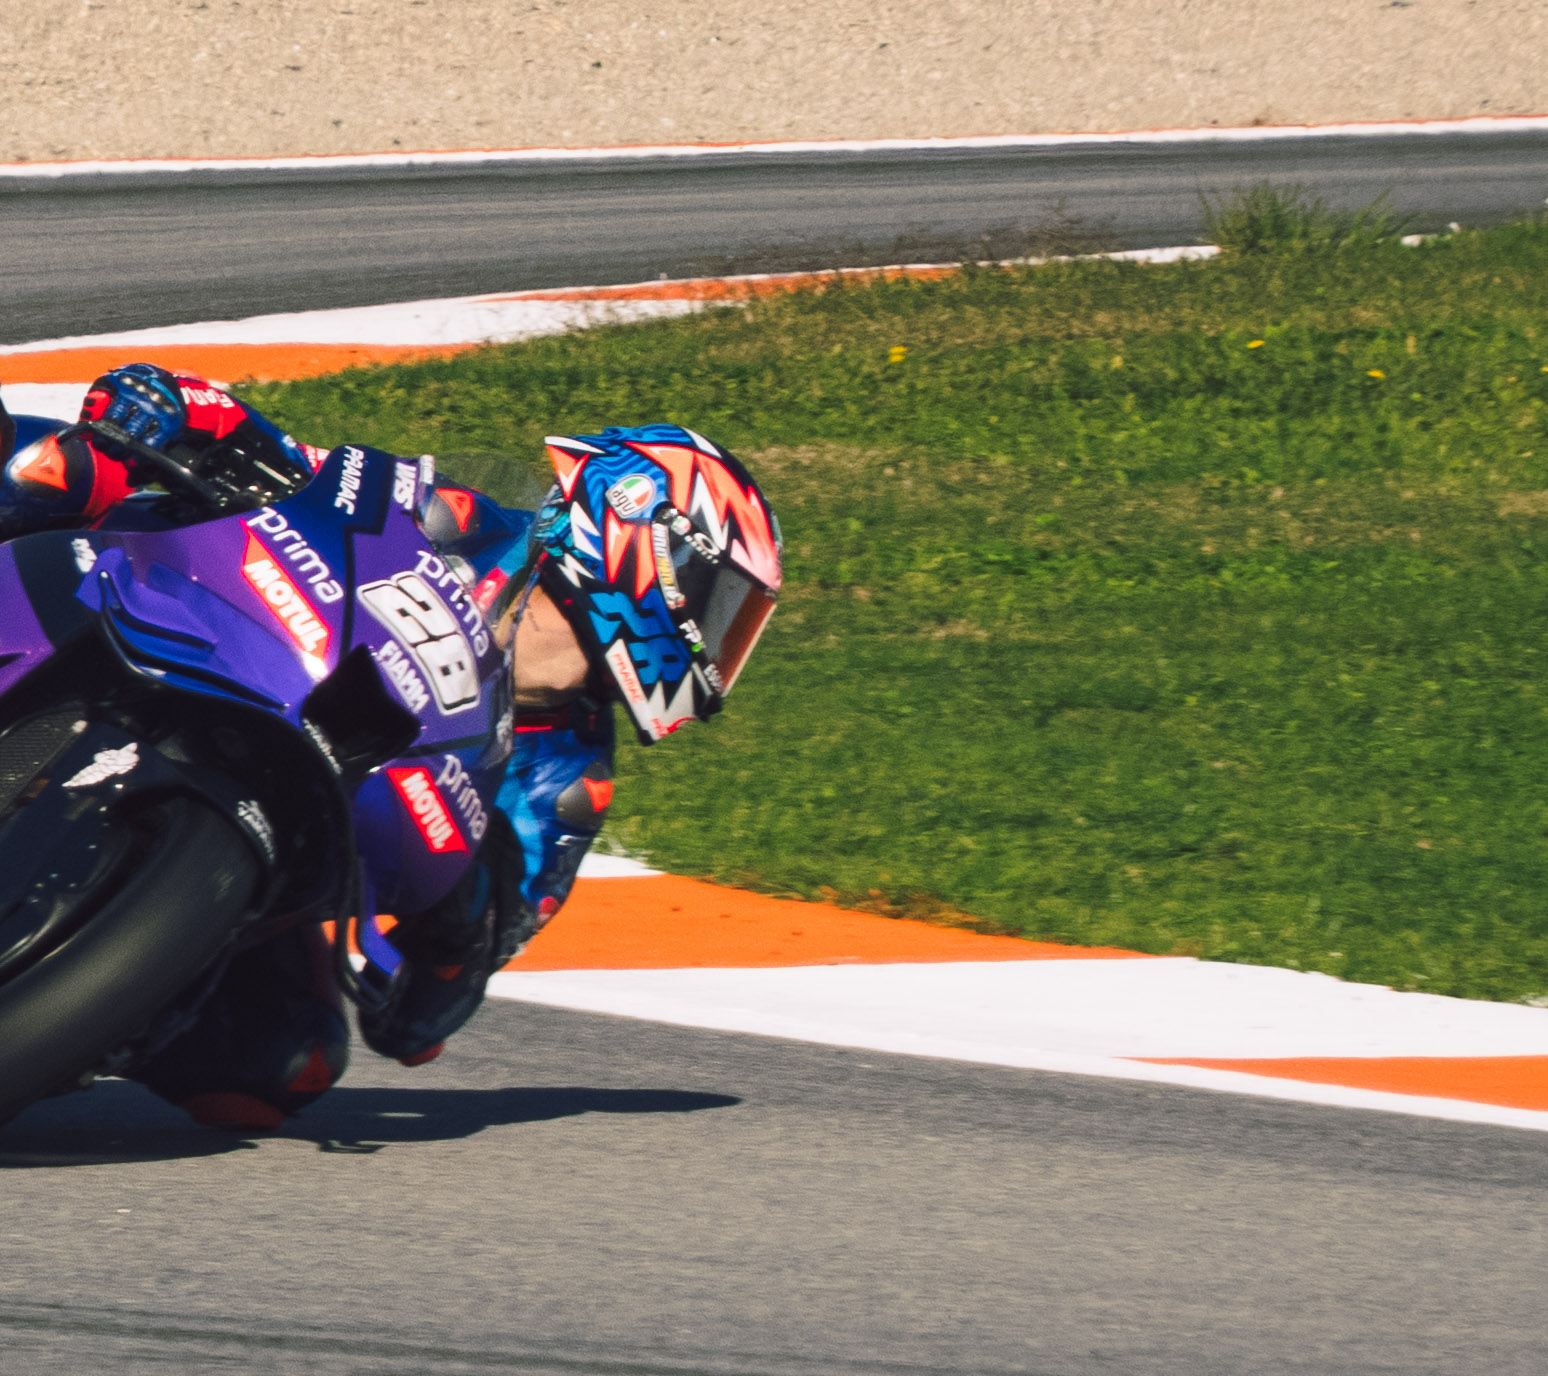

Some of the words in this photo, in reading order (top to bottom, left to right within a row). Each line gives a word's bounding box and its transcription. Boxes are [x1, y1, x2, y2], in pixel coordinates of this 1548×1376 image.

[334, 445, 365, 515] PRAMAC
[611, 488, 638, 515] agv
[246, 506, 344, 604] prima
[244, 559, 329, 651] MOTUL
[357, 570, 481, 716] 28
[372, 640, 430, 714] FIAMM
[401, 771, 454, 850] MOTUL
